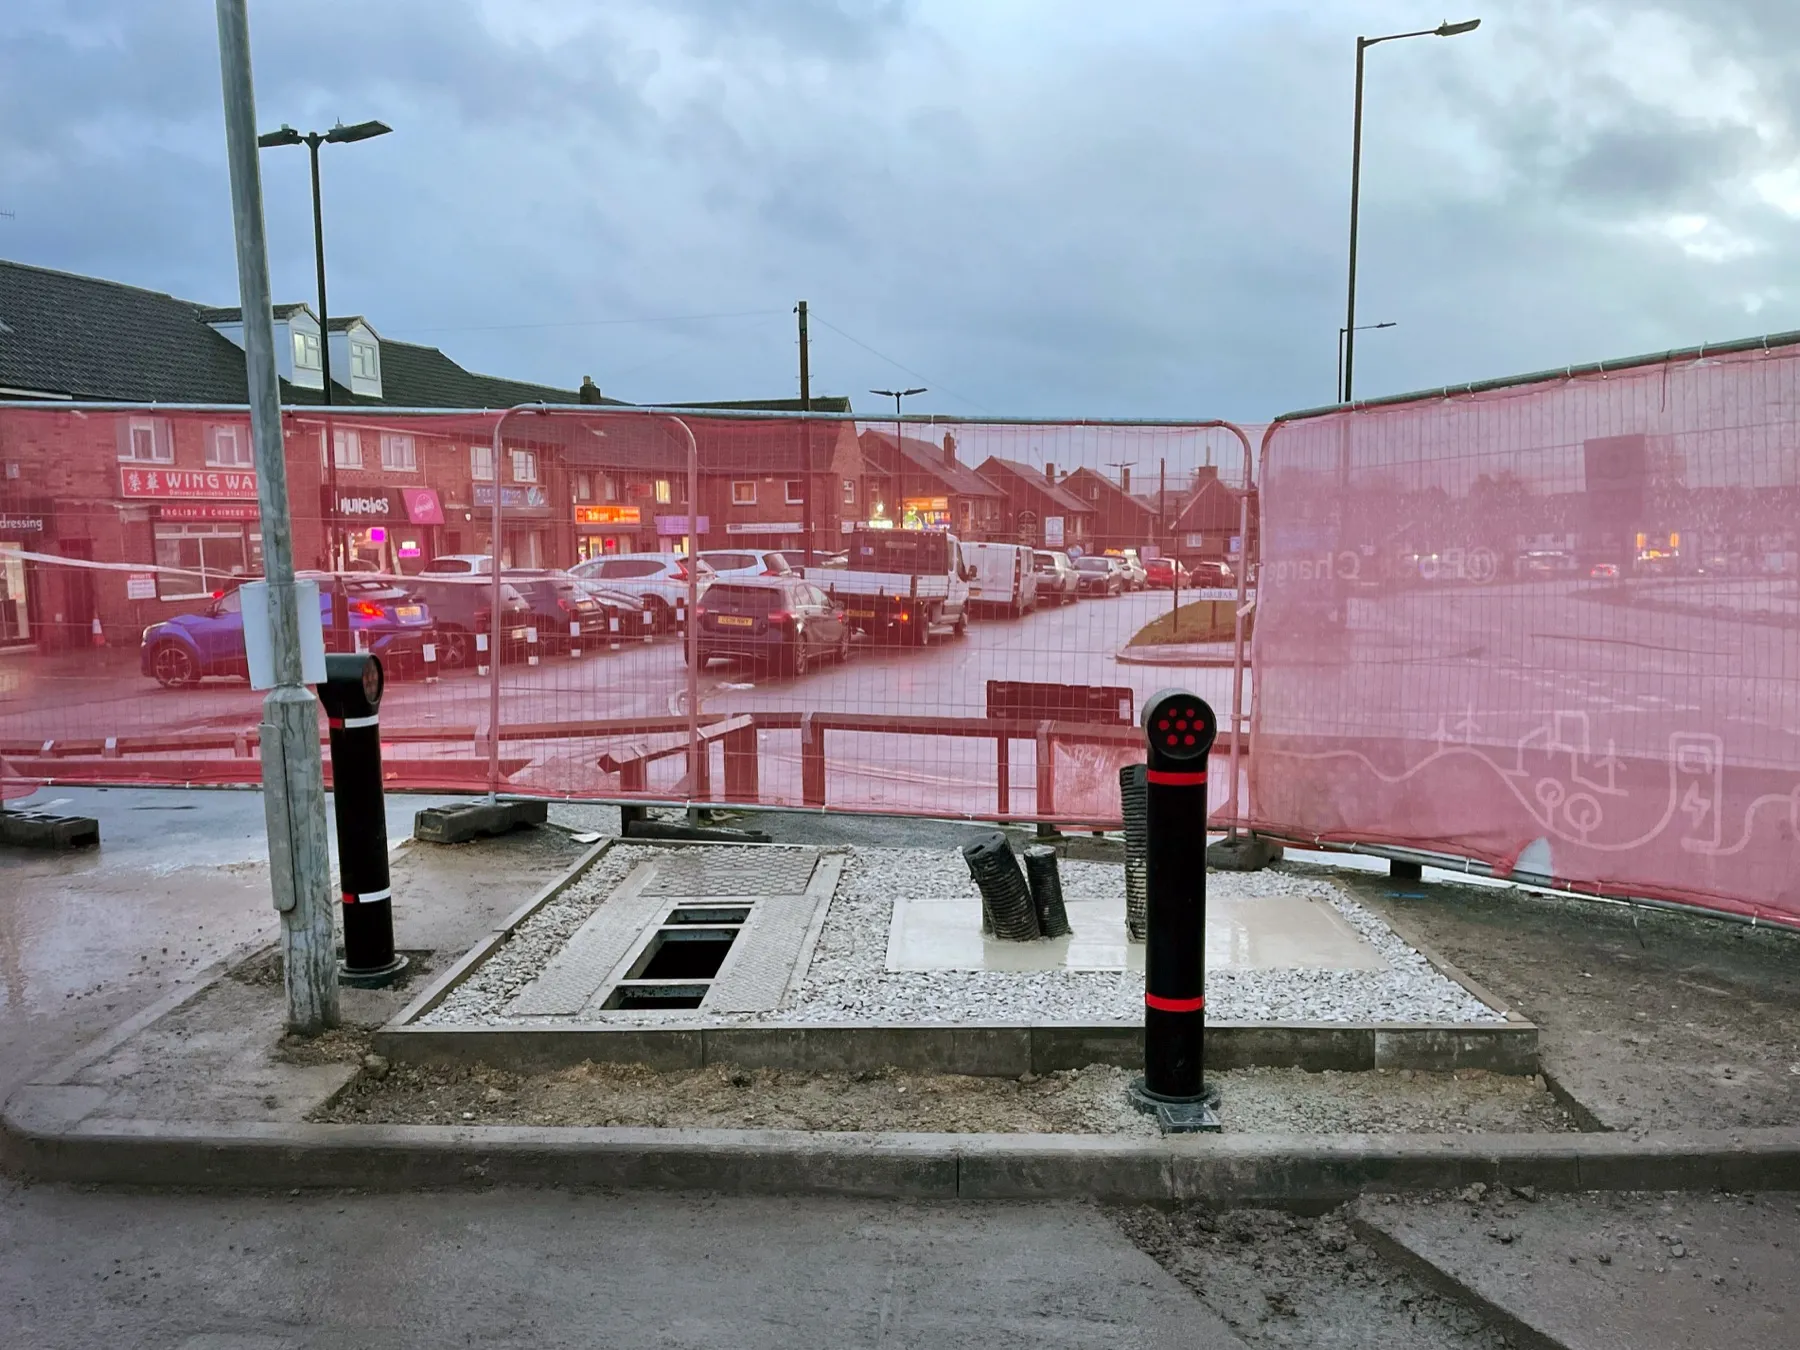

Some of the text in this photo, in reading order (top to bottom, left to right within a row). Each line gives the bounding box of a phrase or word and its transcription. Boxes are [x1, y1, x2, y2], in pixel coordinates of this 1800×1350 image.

[165, 472, 257, 490] WING WA
[160, 508, 197, 516] ENGLISH
[0, 513, 43, 531] dressing
